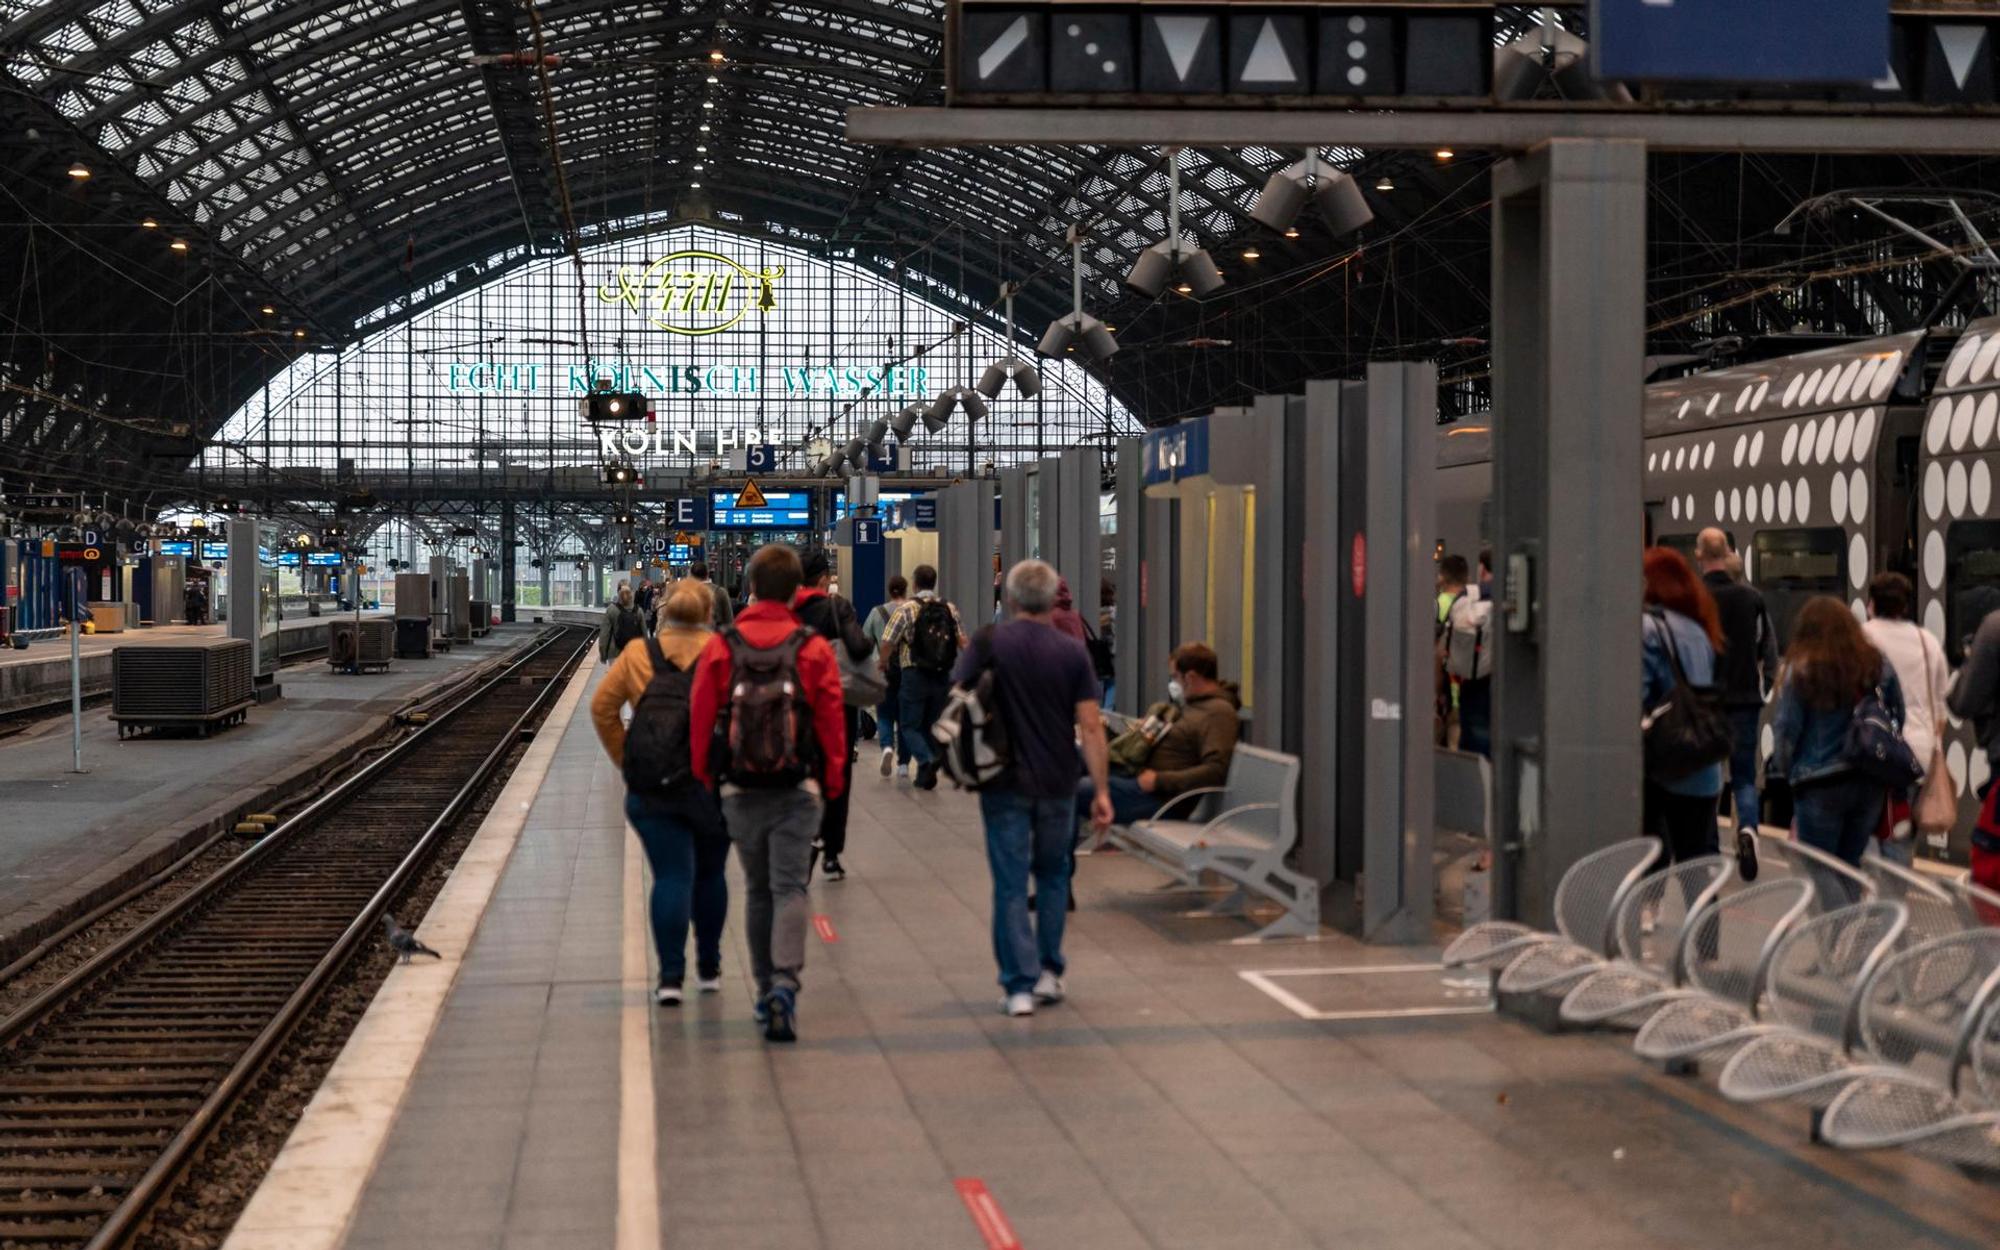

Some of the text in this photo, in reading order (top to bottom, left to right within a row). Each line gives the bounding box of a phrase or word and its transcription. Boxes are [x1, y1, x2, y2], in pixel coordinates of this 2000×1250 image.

[449, 356, 929, 396] ECHT KÖLNISCH WASSER
[600, 427, 696, 456] KÖLN
[751, 445, 765, 466] 5
[678, 498, 694, 523] E
[85, 531, 97, 546] D
[655, 538, 666, 552] D
